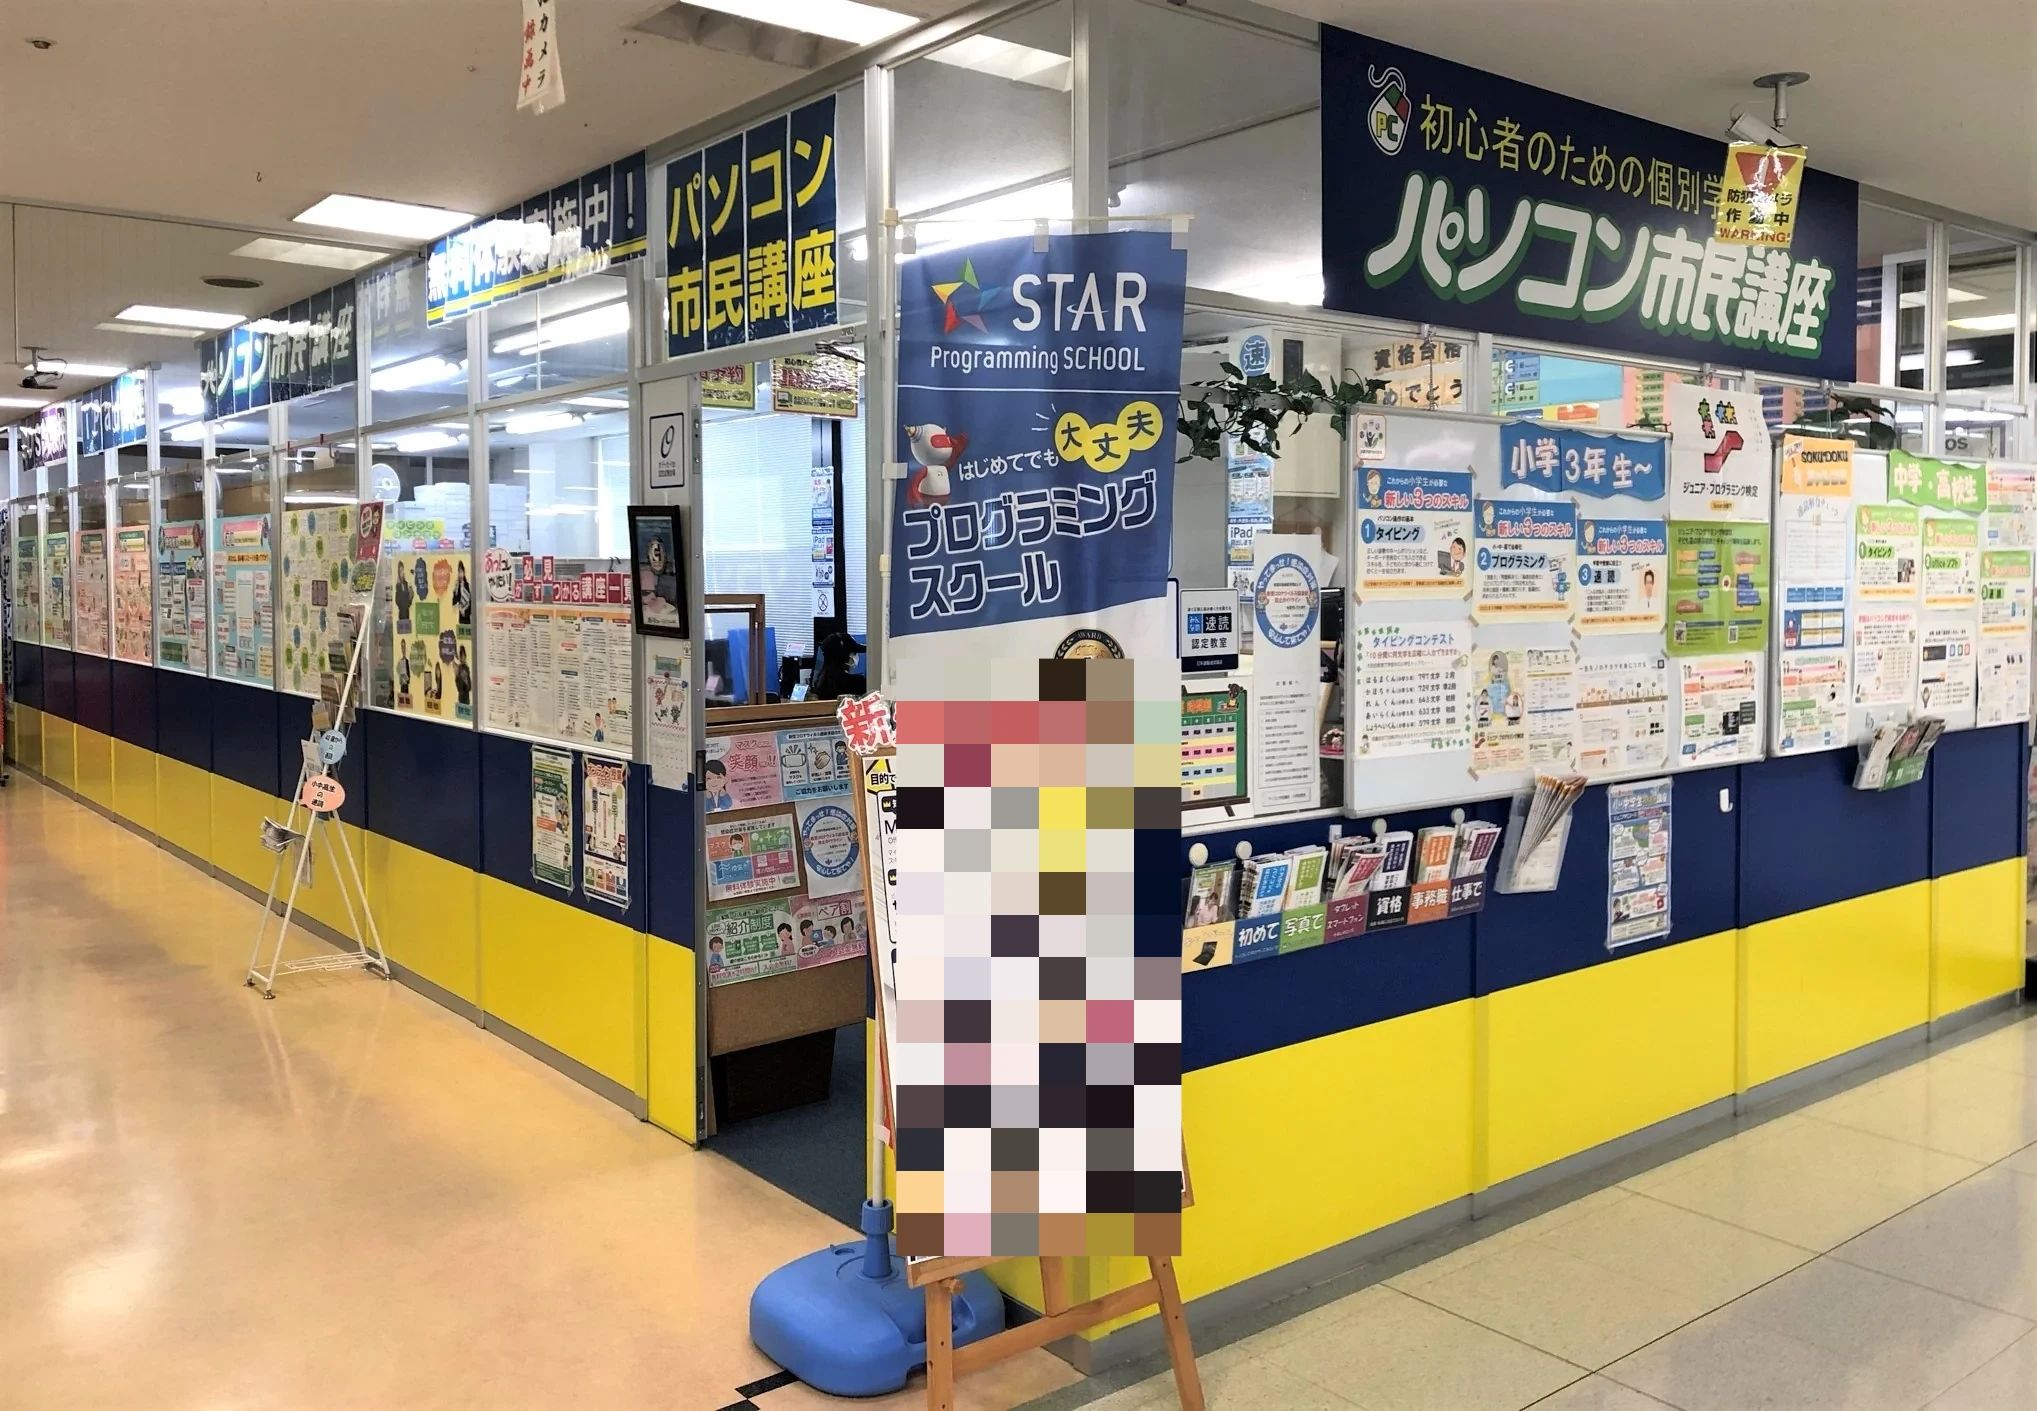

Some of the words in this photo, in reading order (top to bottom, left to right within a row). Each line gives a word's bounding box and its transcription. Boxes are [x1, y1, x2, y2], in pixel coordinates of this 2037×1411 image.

[1375, 114, 1400, 142] PC
[668, 134, 833, 248] パソコン
[1366, 172, 1834, 351] パソコン市民講座
[668, 228, 836, 338] 市民講座
[1012, 272, 1147, 332] STAR
[930, 345, 1059, 374] Programming
[1063, 346, 1146, 372] SCHOOL
[1244, 340, 1266, 372] 速
[1061, 409, 1154, 462] 大丈夫
[958, 448, 1060, 482] はじめてでも
[904, 468, 1157, 560] プログラミング
[1230, 526, 1253, 539] iPad
[1376, 526, 1421, 541] タイピング
[1491, 555, 1546, 569] プログラミング
[910, 551, 1062, 620] スクール
[1205, 615, 1230, 631] 速読
[1192, 637, 1228, 649] 認定教室
[1372, 633, 1456, 649] タイピングコンテスト
[1376, 895, 1402, 915] 資格
[1451, 880, 1484, 903] 仕事で
[1238, 921, 1280, 948] 初めて
